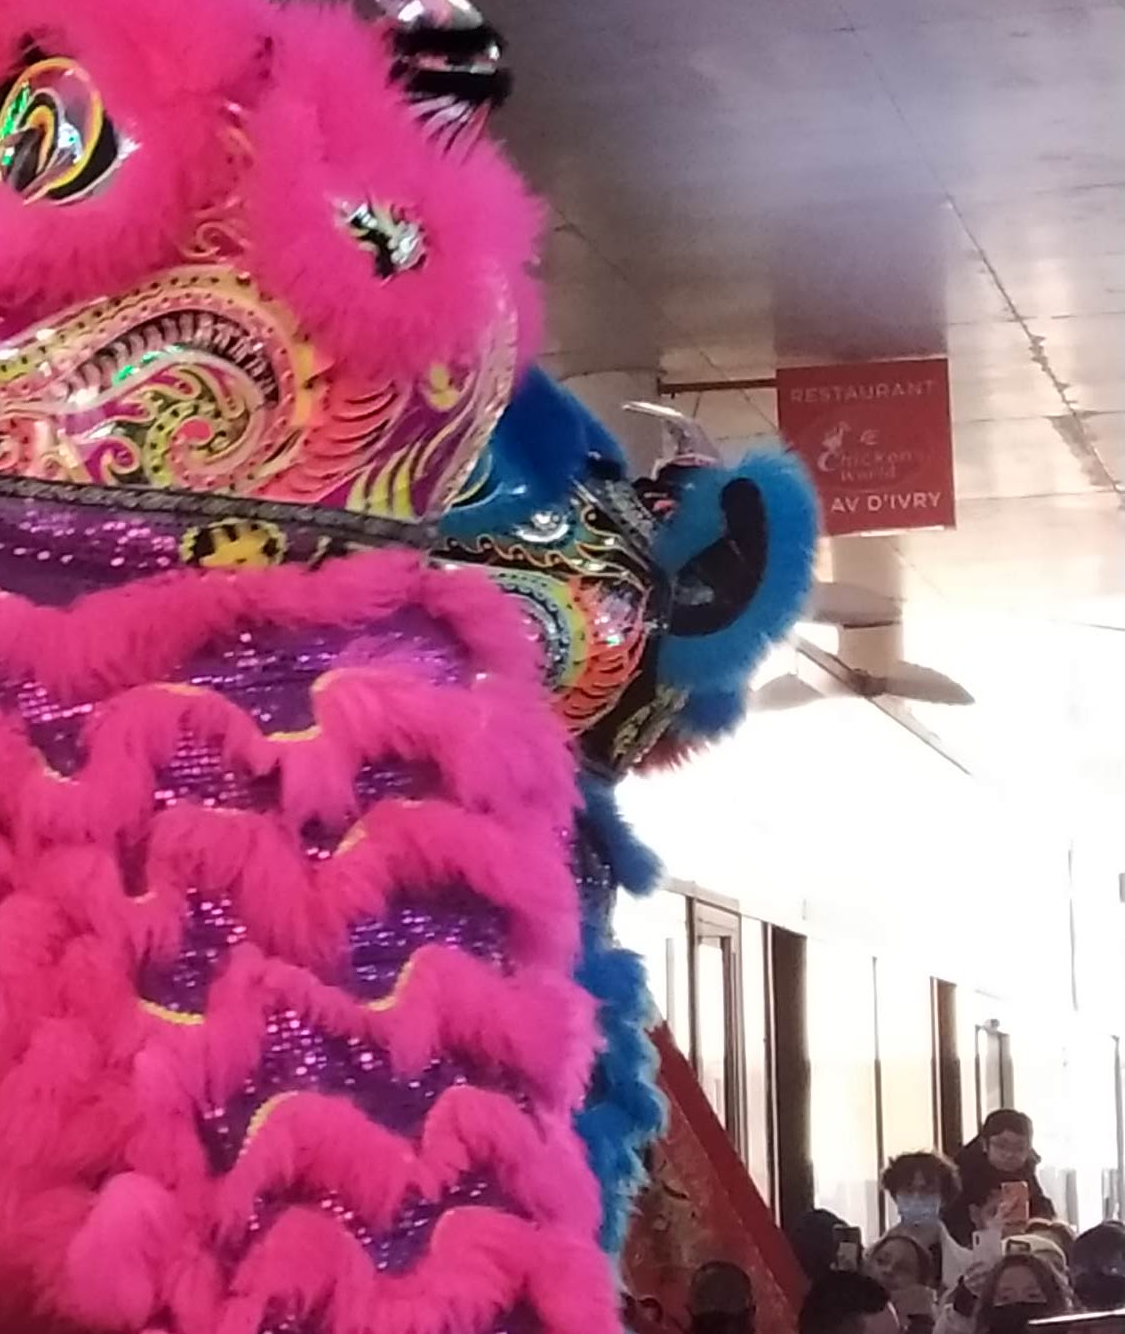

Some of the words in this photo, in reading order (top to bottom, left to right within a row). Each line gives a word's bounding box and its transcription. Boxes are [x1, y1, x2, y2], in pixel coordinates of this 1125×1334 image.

[790, 380, 936, 403] RESTAURANT
[831, 495, 859, 513] AV
[867, 492, 941, 512] D'IVRY
